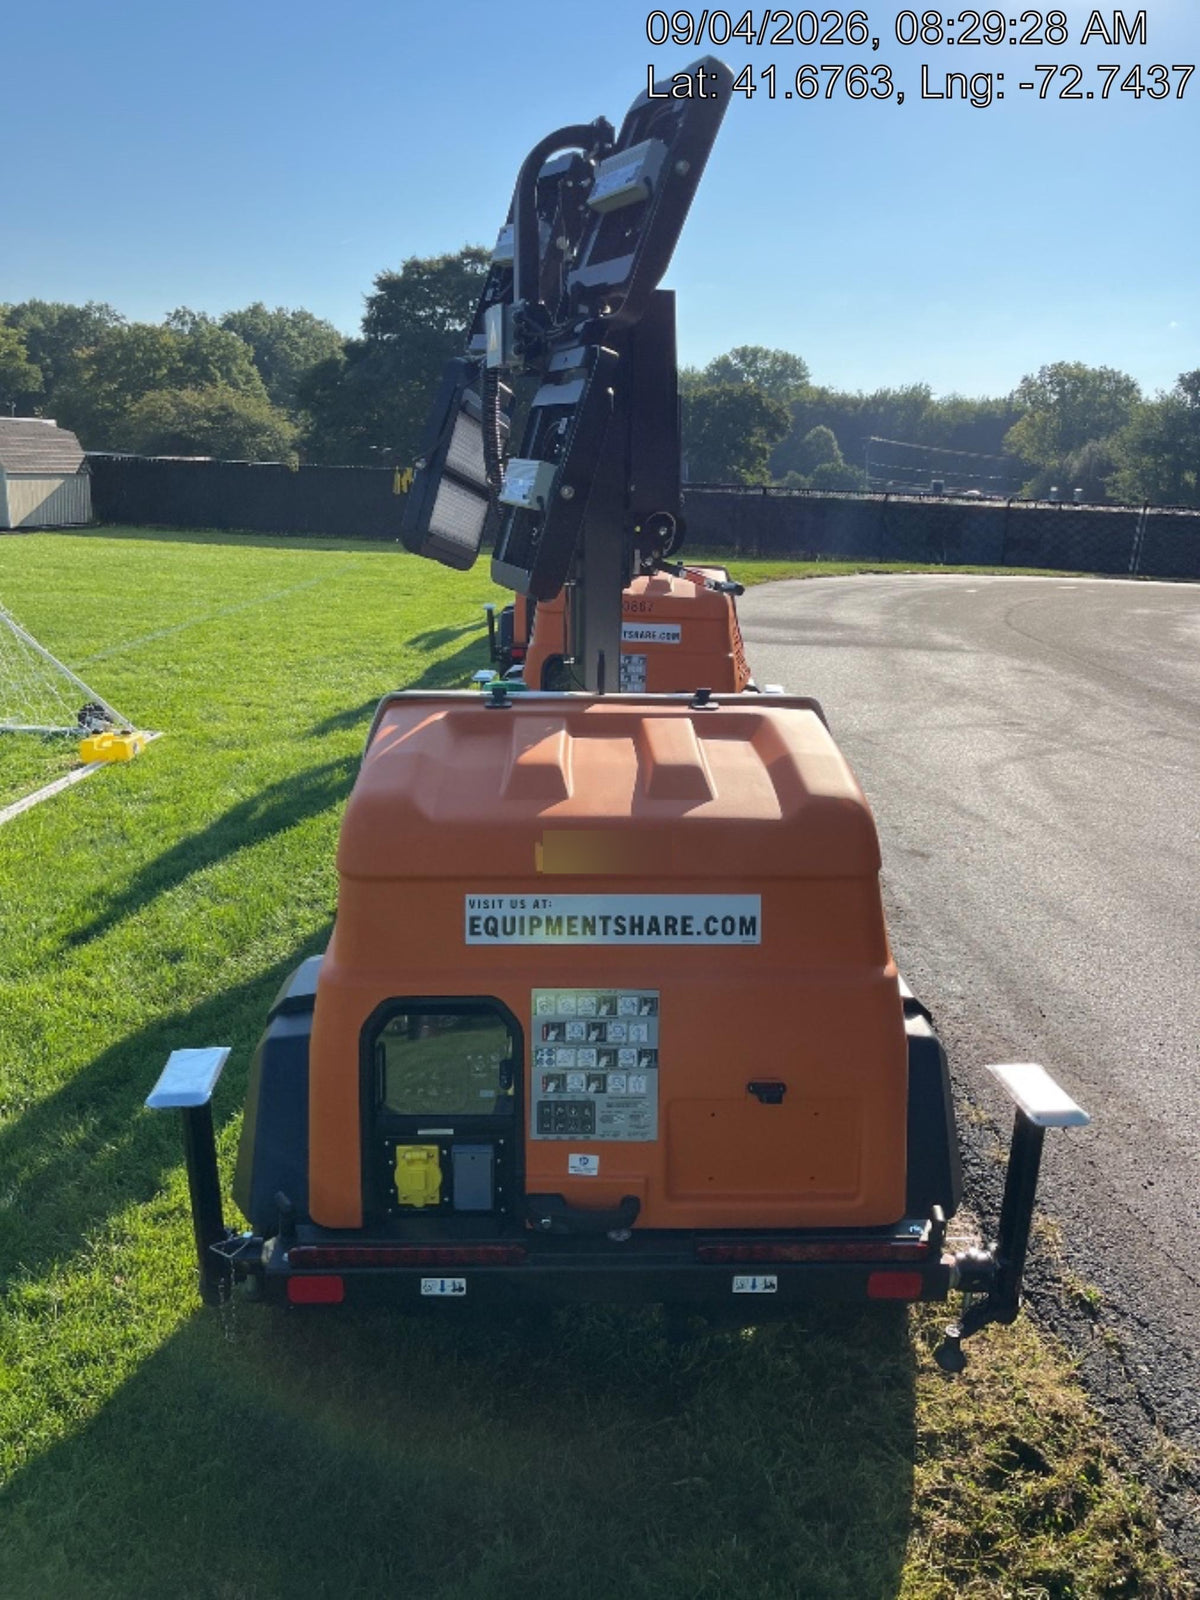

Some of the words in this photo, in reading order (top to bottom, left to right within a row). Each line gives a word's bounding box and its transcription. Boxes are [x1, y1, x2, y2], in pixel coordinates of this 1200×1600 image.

[468, 899, 503, 909] VISIT
[510, 899, 526, 909] US
[532, 899, 552, 909] AT:
[468, 915, 757, 937] EQUIPMENTSHARE.COM
